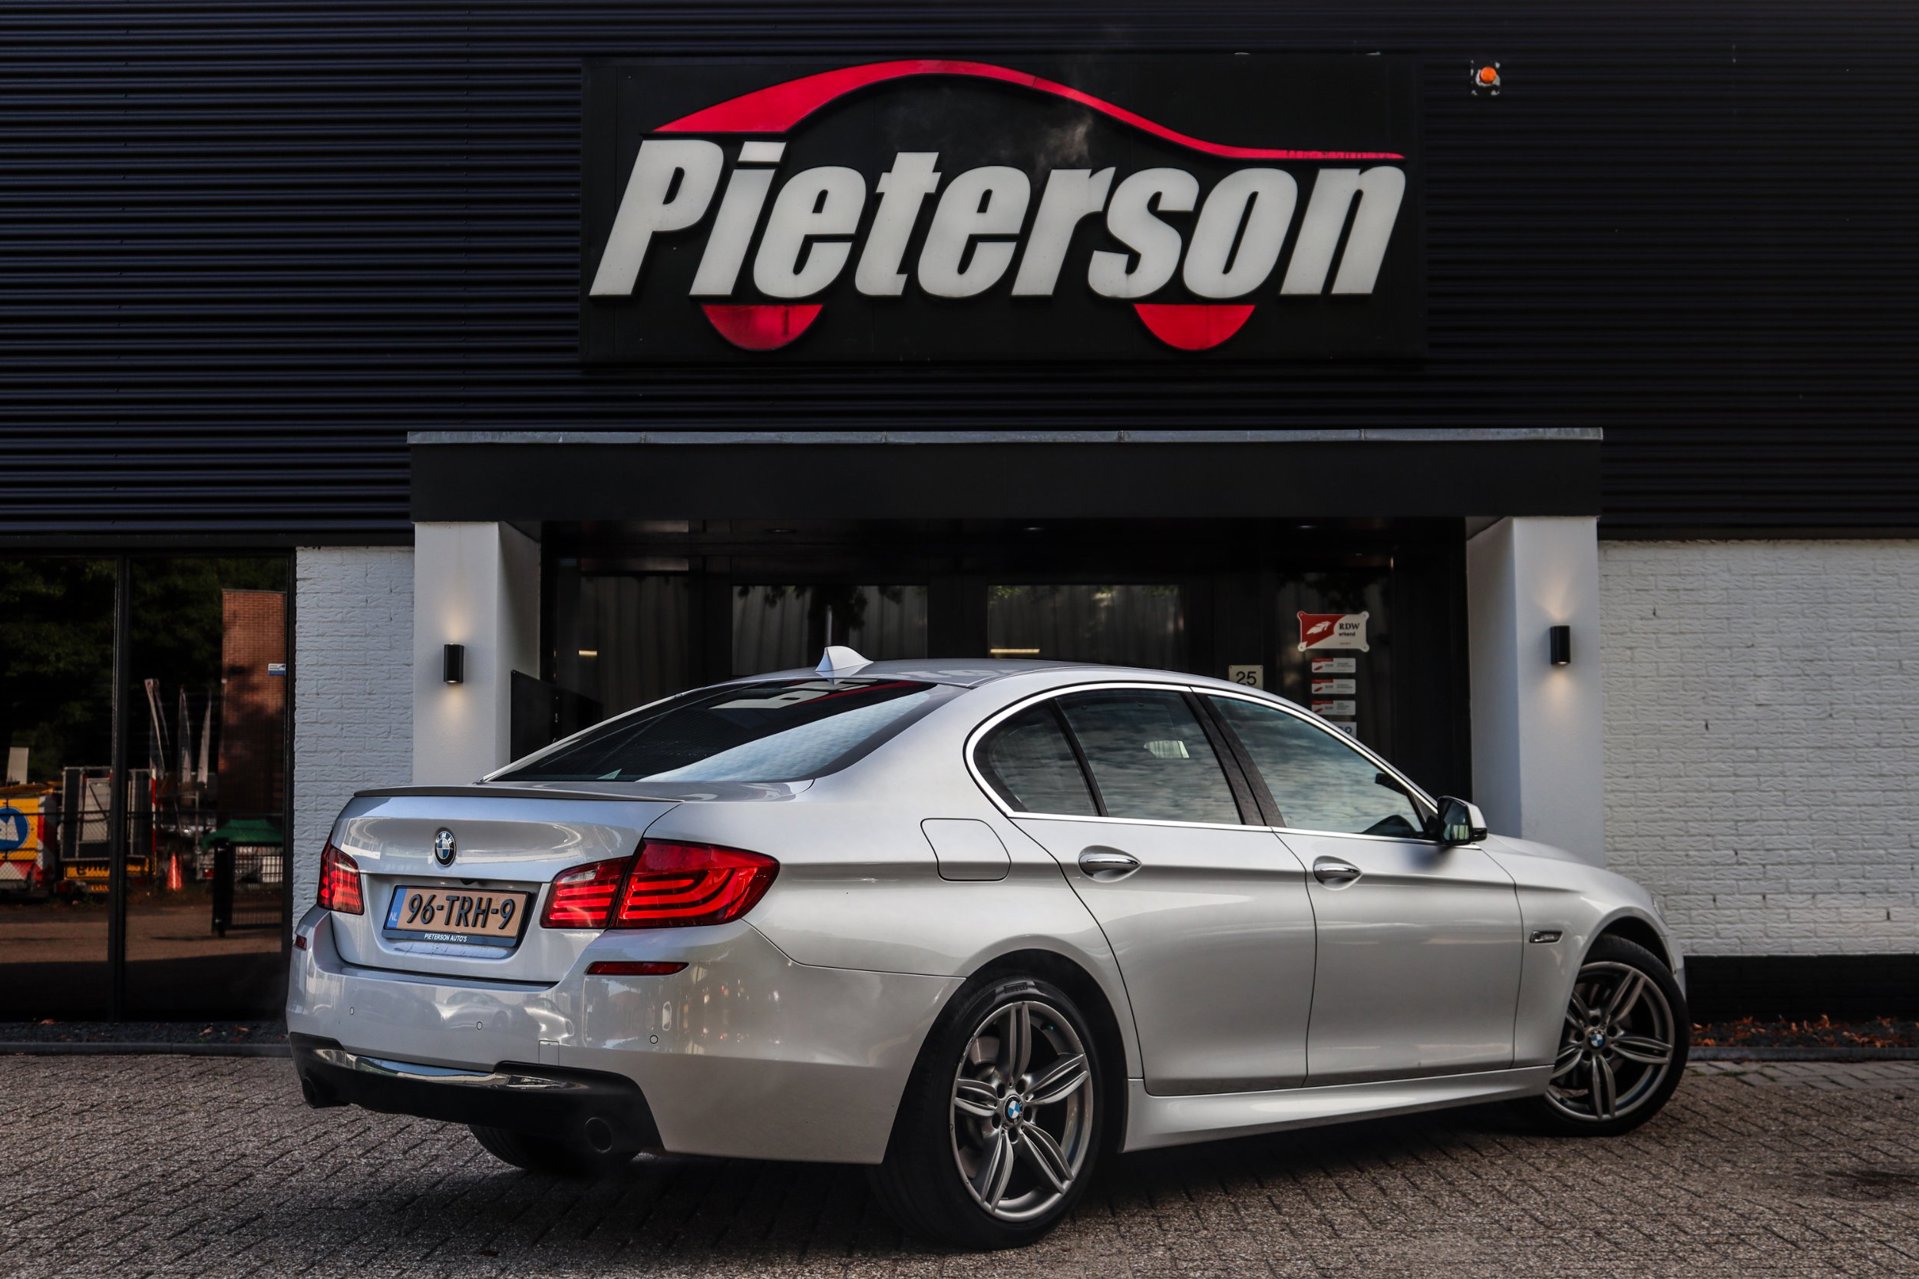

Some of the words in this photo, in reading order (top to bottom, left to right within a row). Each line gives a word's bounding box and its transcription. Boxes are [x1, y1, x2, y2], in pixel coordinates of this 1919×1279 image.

[589, 139, 1405, 298] Pieterson
[1338, 622, 1360, 630] RDW
[1236, 671, 1257, 686] 25
[388, 911, 398, 921] NL
[406, 893, 516, 930] 96-TRH-9
[424, 933, 450, 941] PIETERSON
[450, 935, 468, 943] AUTO'S
